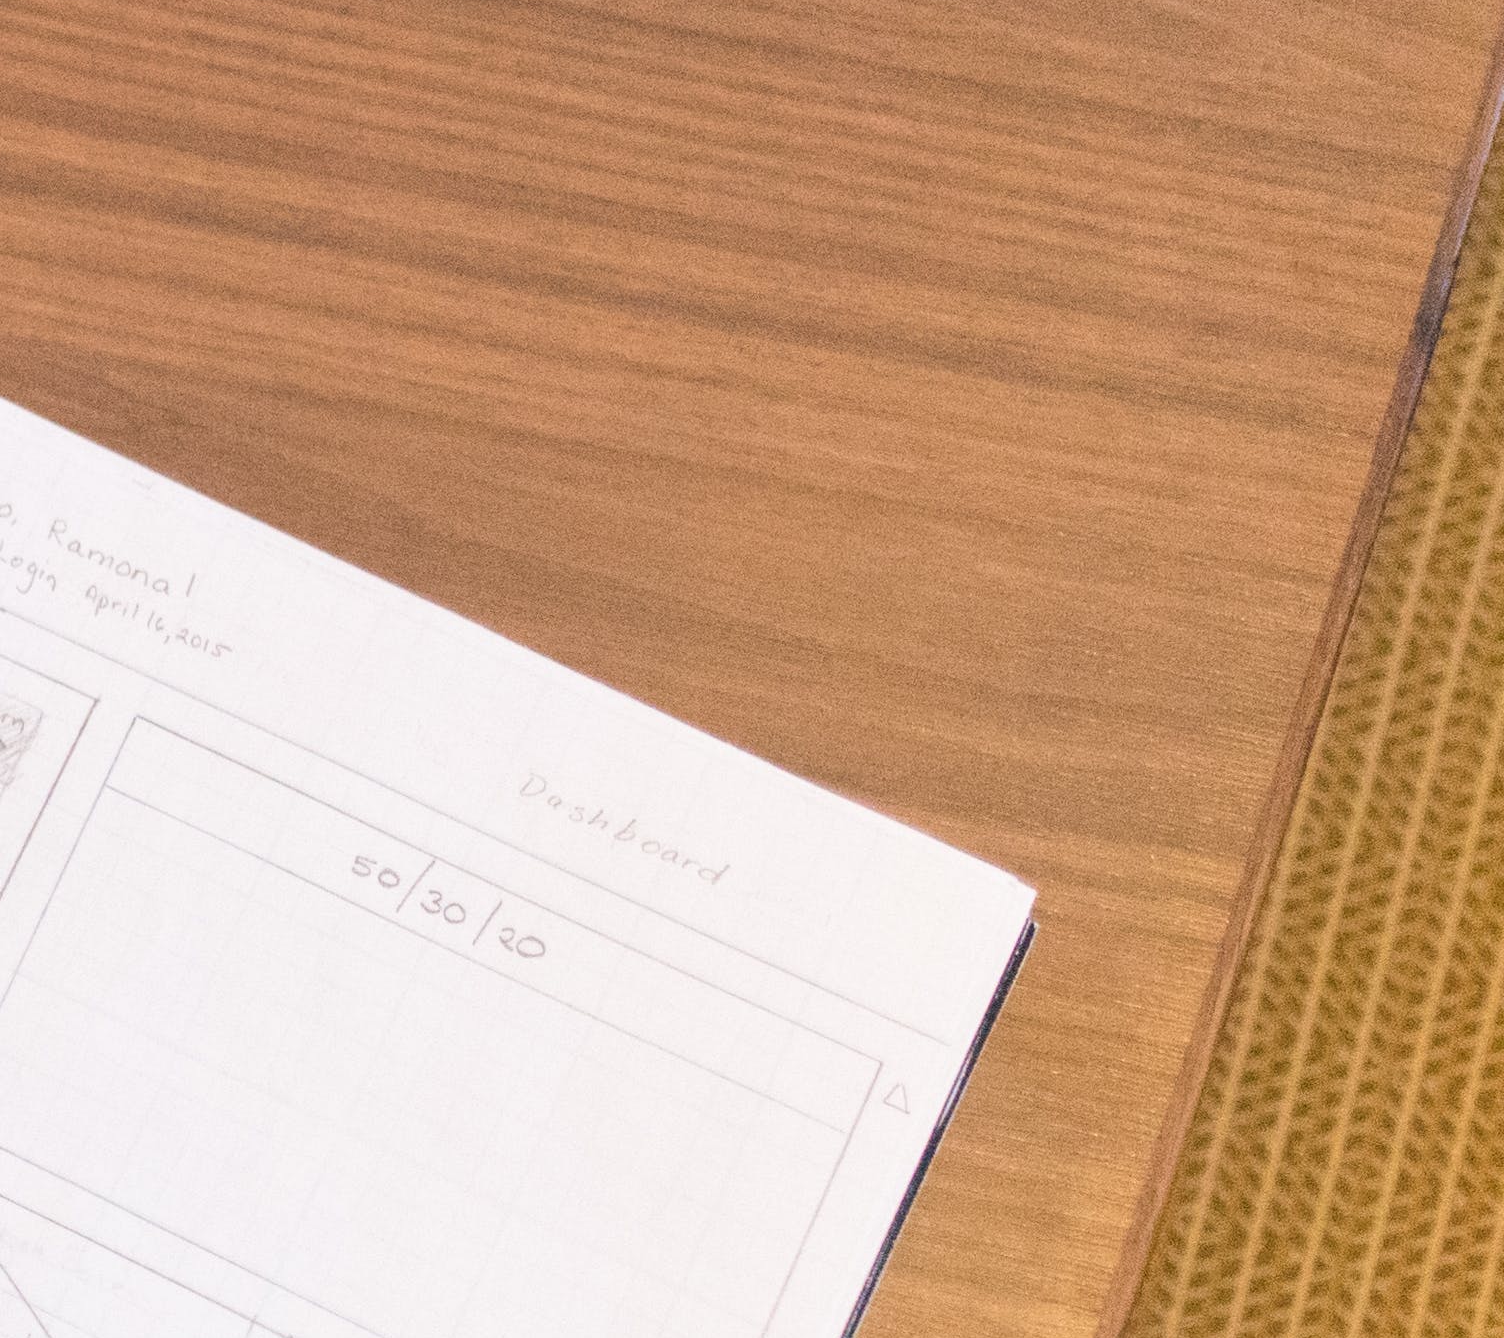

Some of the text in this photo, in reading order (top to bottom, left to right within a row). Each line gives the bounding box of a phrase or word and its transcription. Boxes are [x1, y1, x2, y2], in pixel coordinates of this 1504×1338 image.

[46, 517, 198, 598] Ramona!
[83, 583, 141, 619] April
[518, 772, 732, 886] Dashboard
